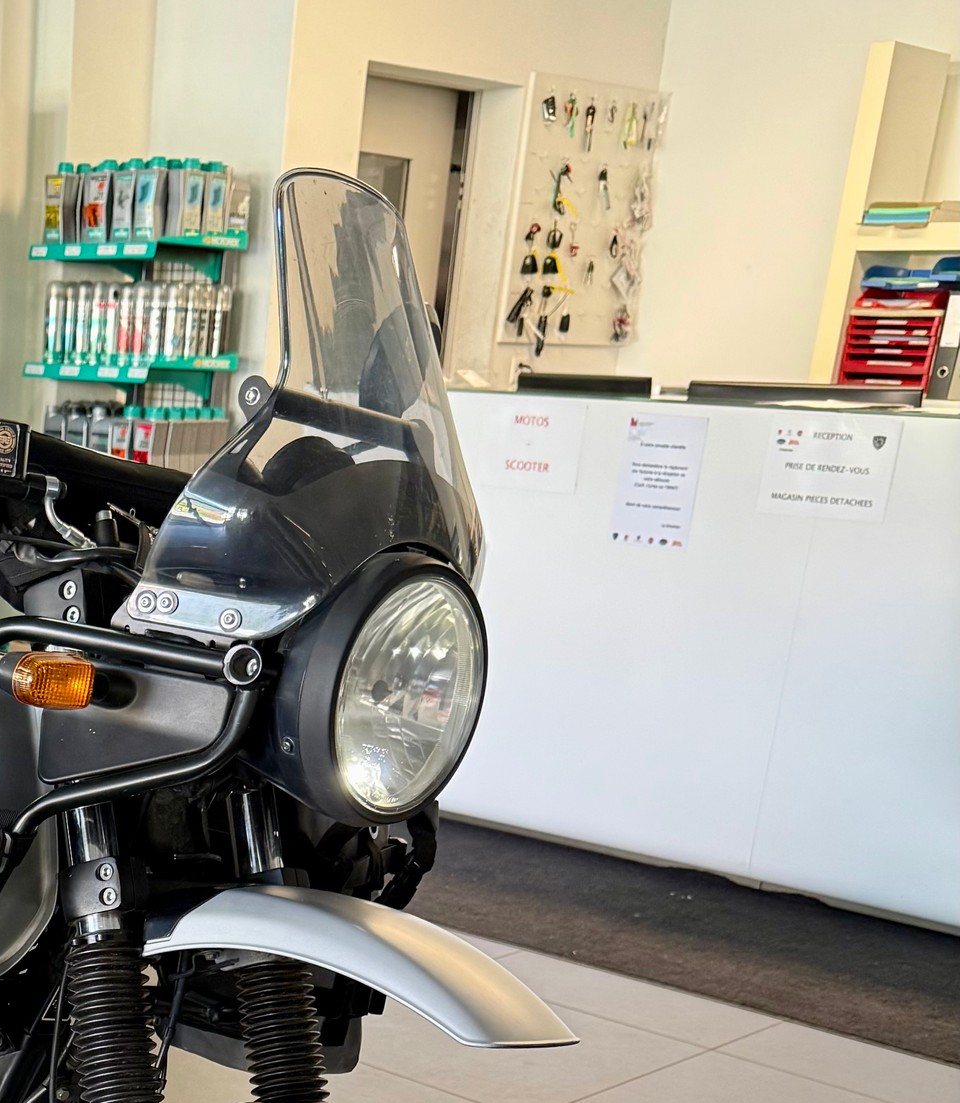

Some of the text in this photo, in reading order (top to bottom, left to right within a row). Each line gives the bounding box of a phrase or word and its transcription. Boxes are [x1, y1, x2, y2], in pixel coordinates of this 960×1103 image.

[514, 415, 549, 427] MOTOS
[813, 431, 853, 441] RECEPTION
[505, 459, 549, 473] SCOOTER
[785, 462, 870, 475] PRISE DE RENDEZ-VOUS
[771, 491, 872, 508] MAGASIN PIECES DETACHEES
